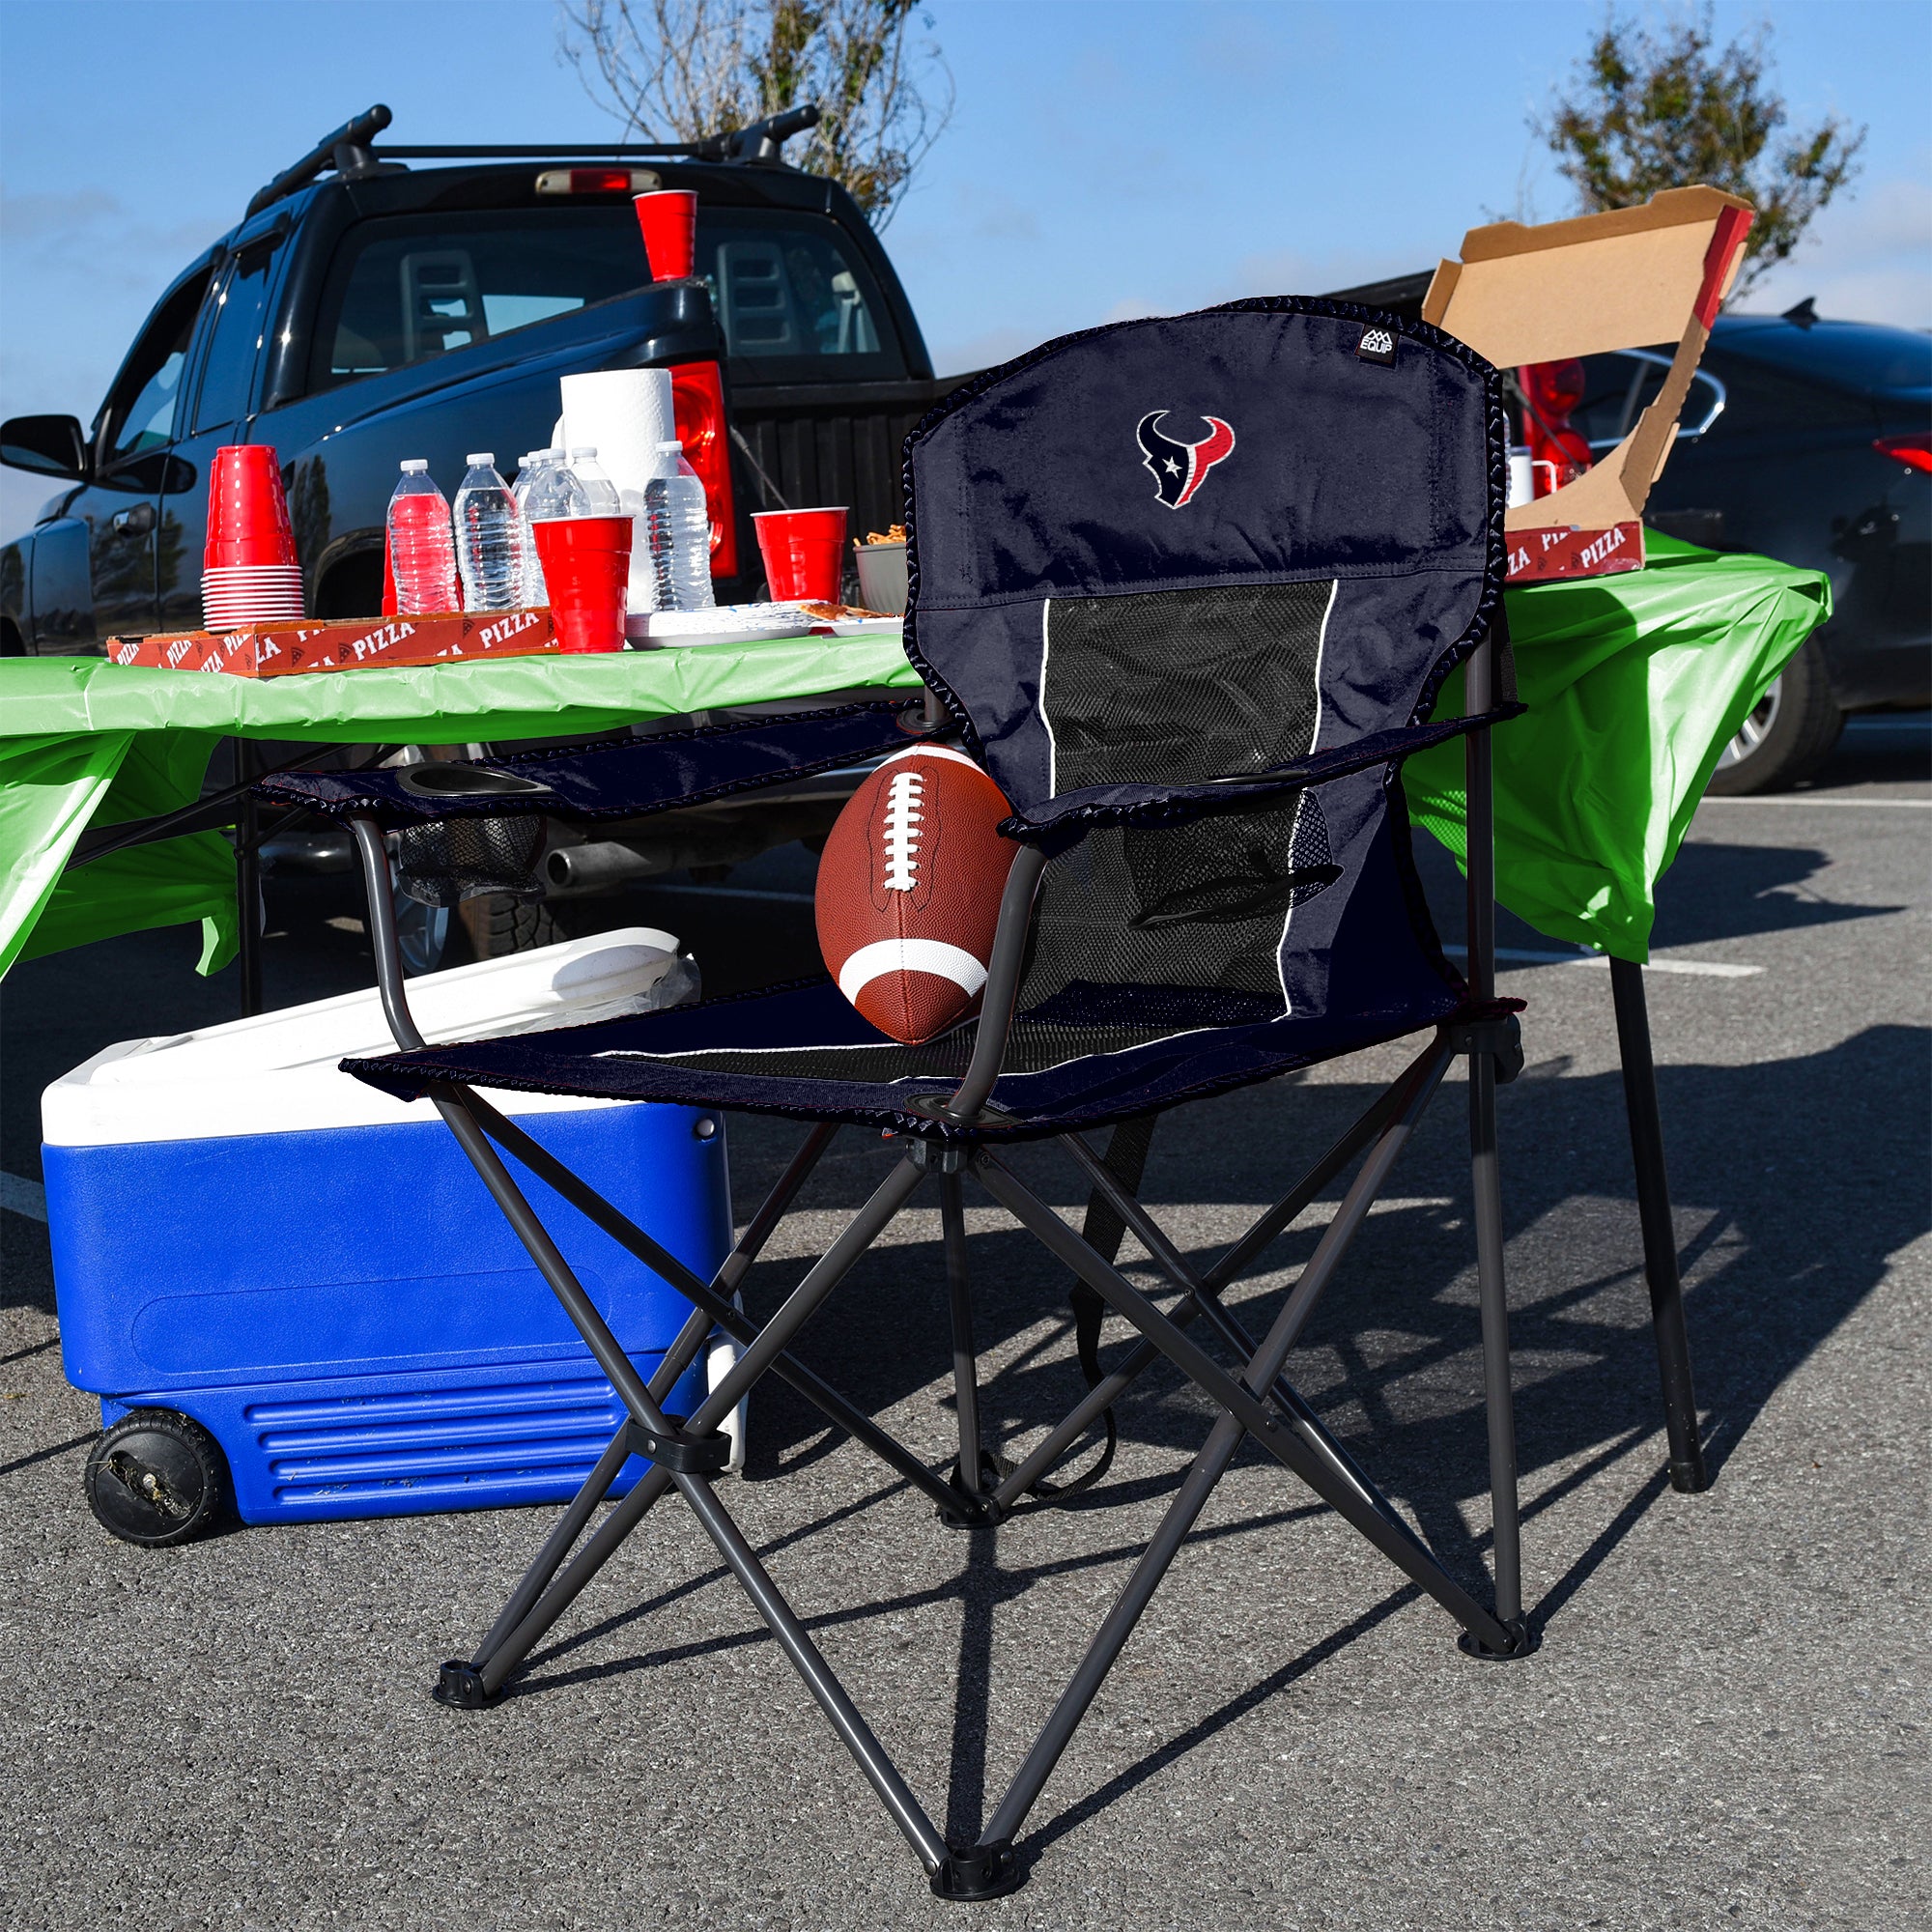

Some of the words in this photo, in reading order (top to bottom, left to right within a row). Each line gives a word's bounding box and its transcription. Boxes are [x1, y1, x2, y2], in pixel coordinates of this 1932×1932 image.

[1360, 337, 1392, 355] EQUIP
[1579, 527, 1626, 569] PIZZA
[352, 622, 415, 661] PIZZA
[479, 612, 540, 649] PIZZA
